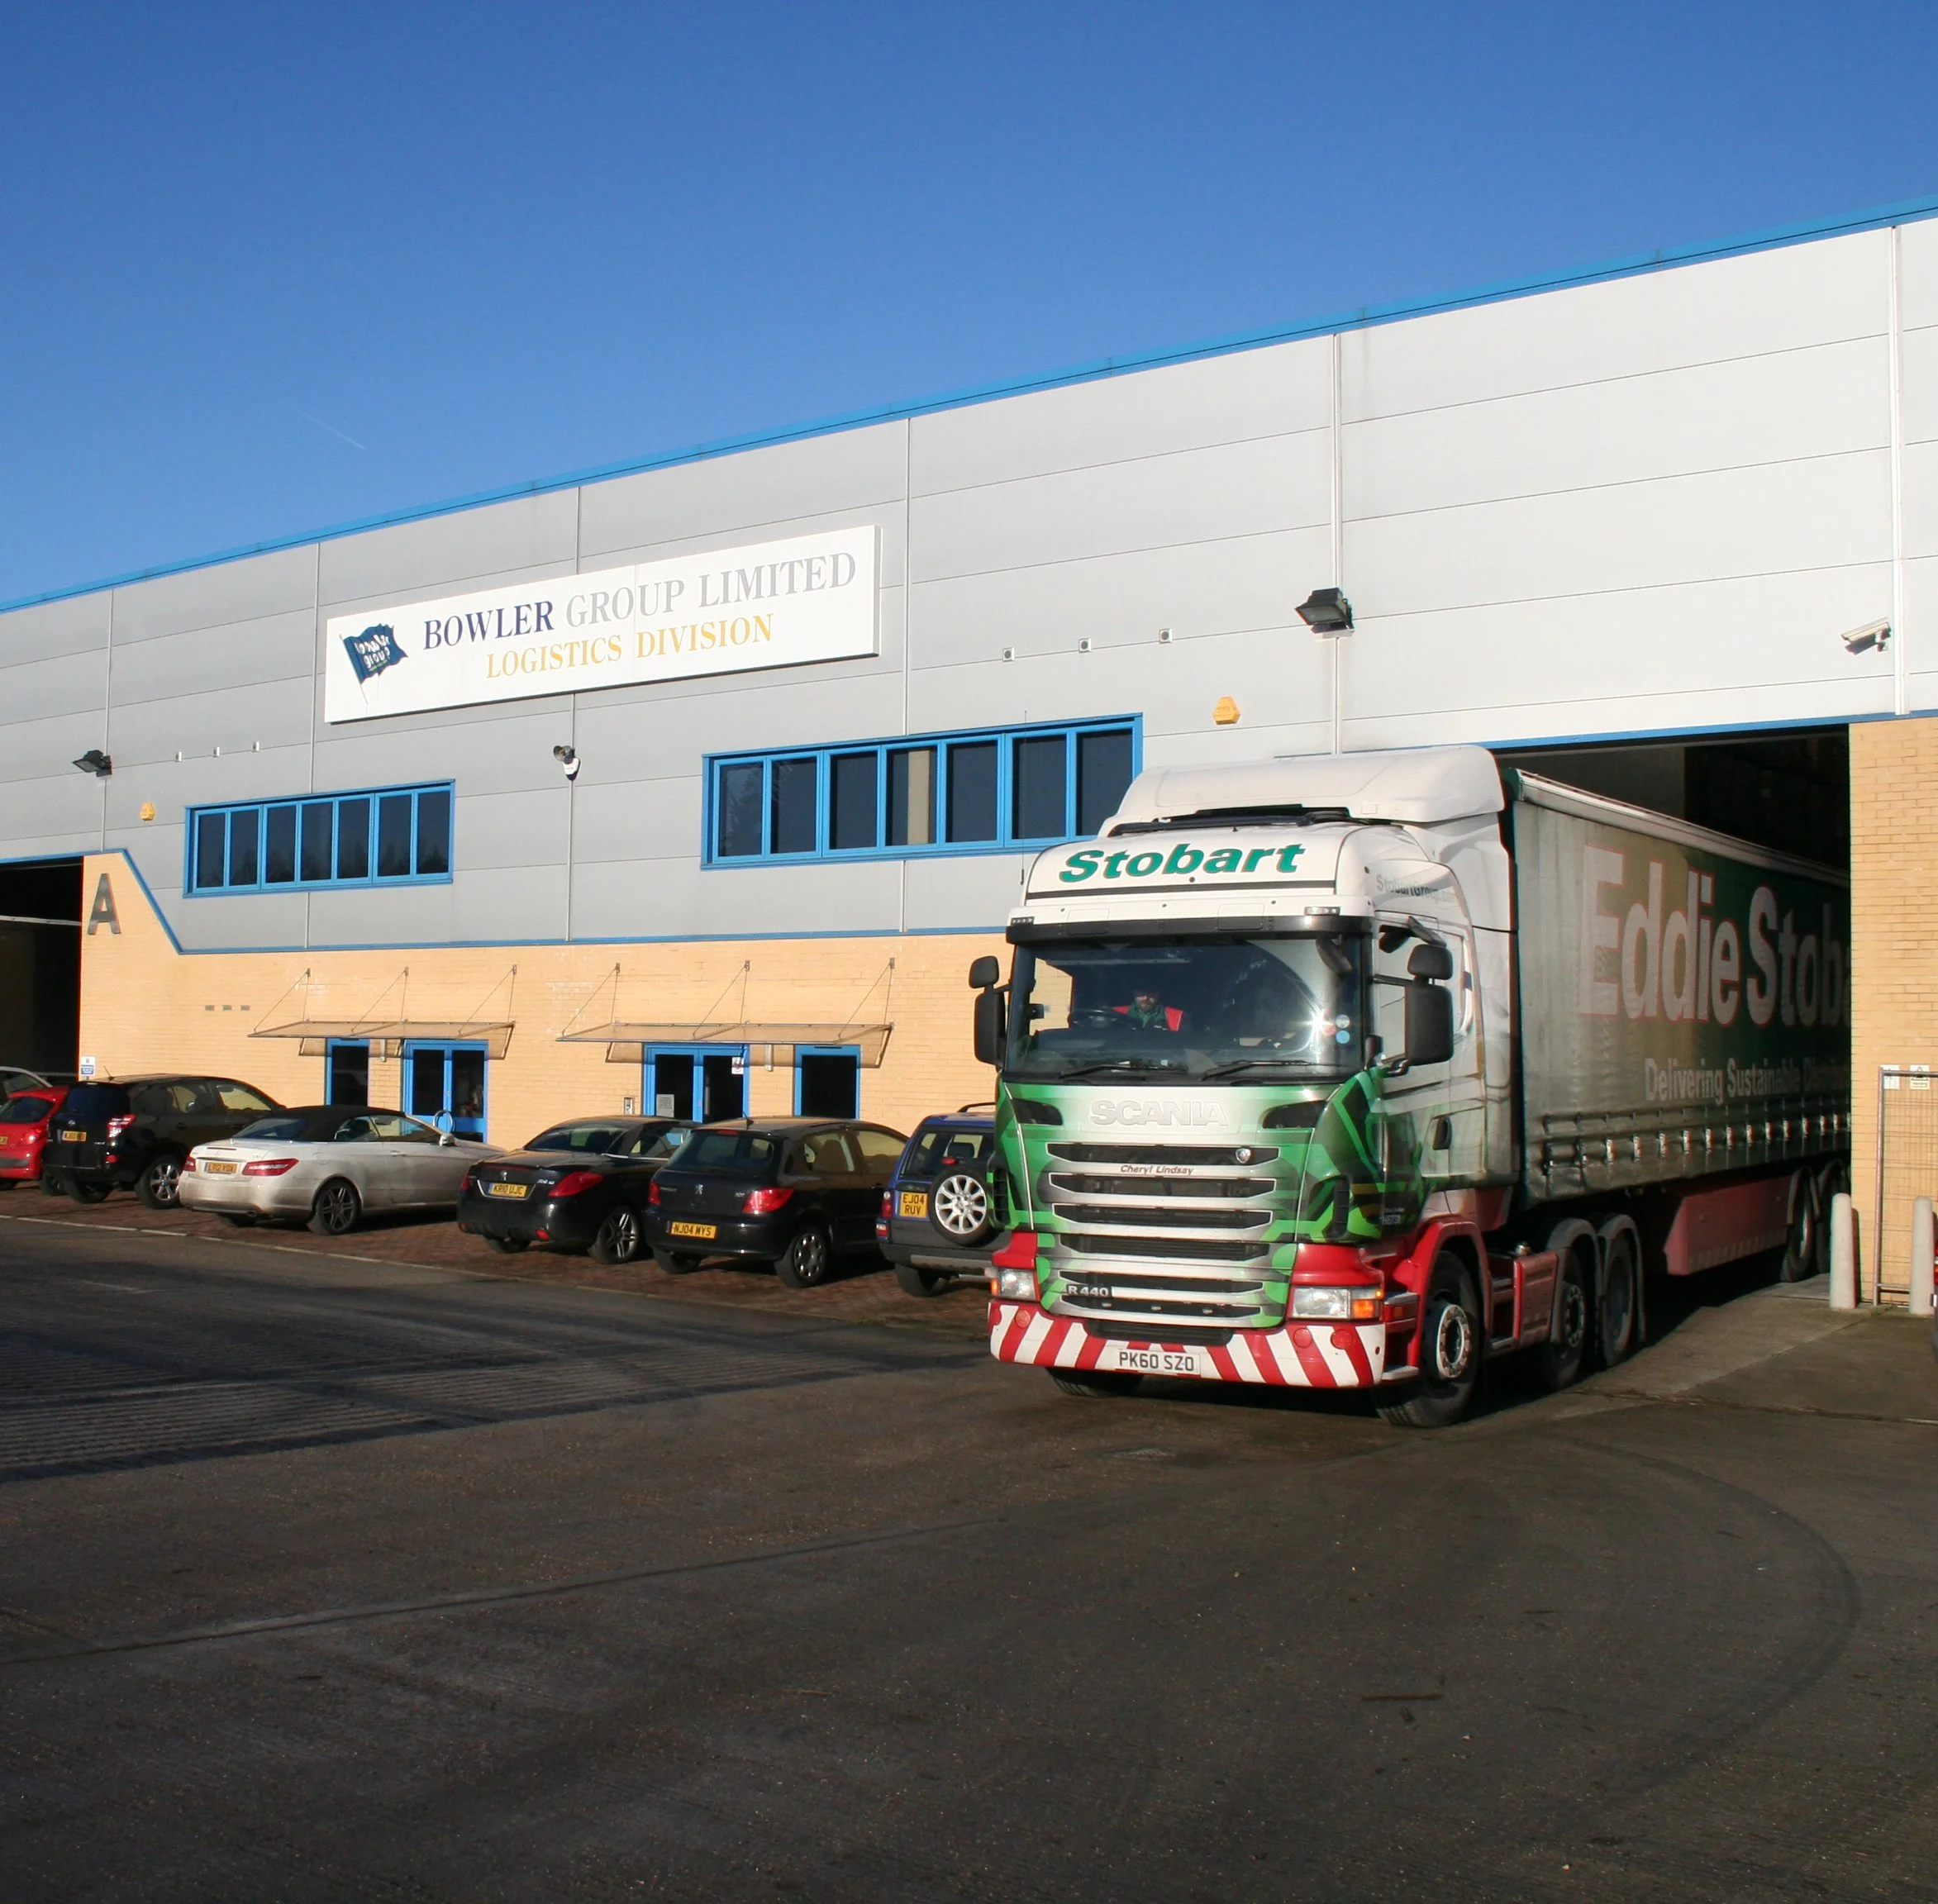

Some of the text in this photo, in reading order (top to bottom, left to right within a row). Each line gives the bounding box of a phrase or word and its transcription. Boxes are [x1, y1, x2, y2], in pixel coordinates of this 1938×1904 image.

[423, 552, 856, 650] BOWLER GROUP LIMITED
[487, 613, 774, 678] LOGISTICS DIVISION
[1059, 843, 1306, 883] Stobart
[87, 873, 121, 935] A
[1578, 844, 1740, 1027] Eddie
[1645, 1058, 1724, 1106] Delivering
[1726, 1057, 1801, 1098] Sustainable
[1090, 1100, 1229, 1126] SCANIA
[1121, 1165, 1194, 1175] Cheryl Lindsay
[902, 1194, 925, 1204] EJ04
[674, 1224, 693, 1234] NJ04
[1068, 1285, 1109, 1297] R 440
[1119, 1351, 1194, 1371] PK60 SZO
